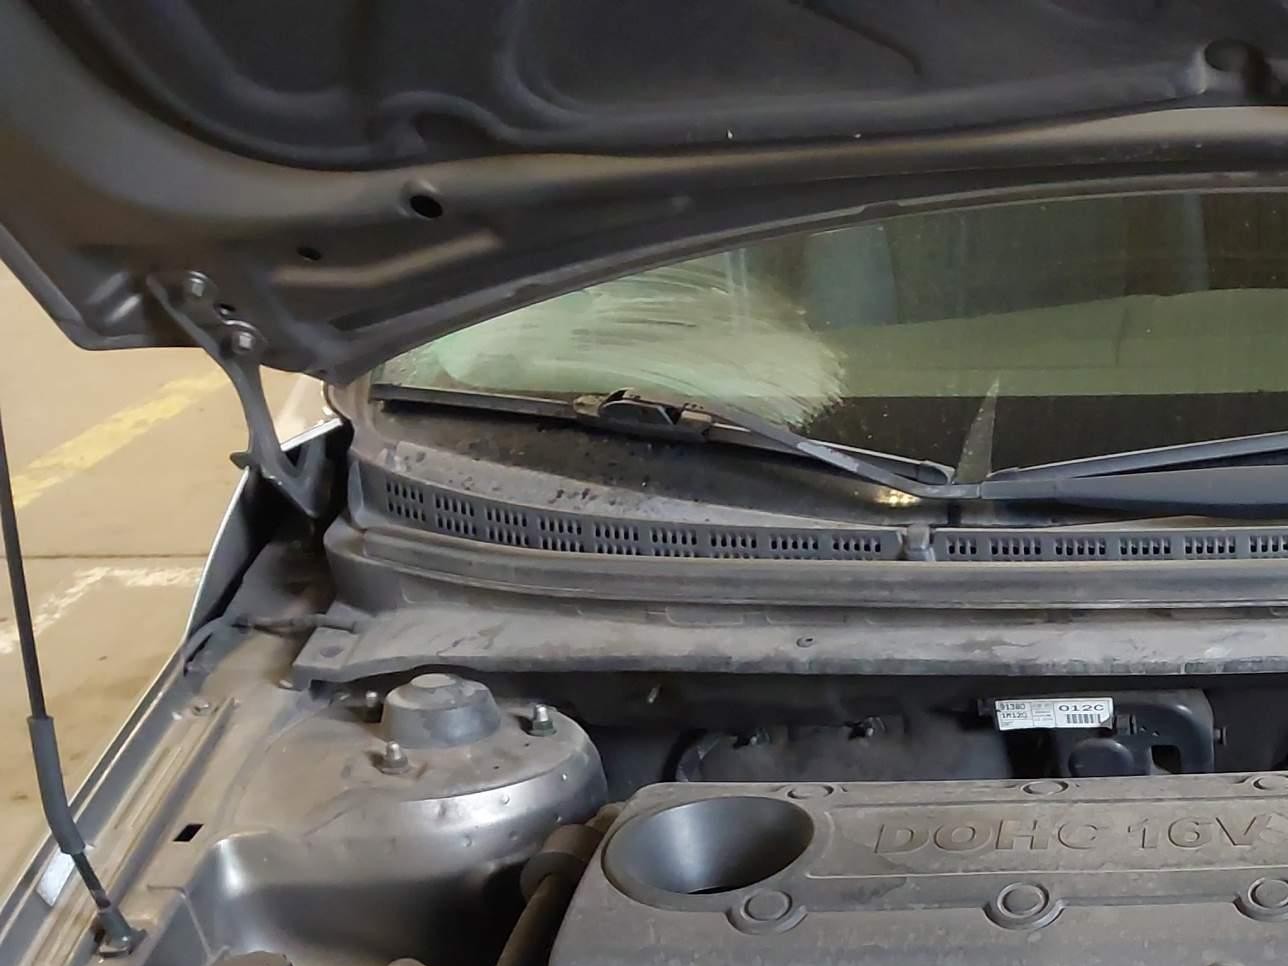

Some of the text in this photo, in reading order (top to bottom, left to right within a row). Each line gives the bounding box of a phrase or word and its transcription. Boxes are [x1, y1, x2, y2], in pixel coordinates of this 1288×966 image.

[1058, 704, 1105, 712] 012C
[873, 814, 1267, 853] DOHC 16V
